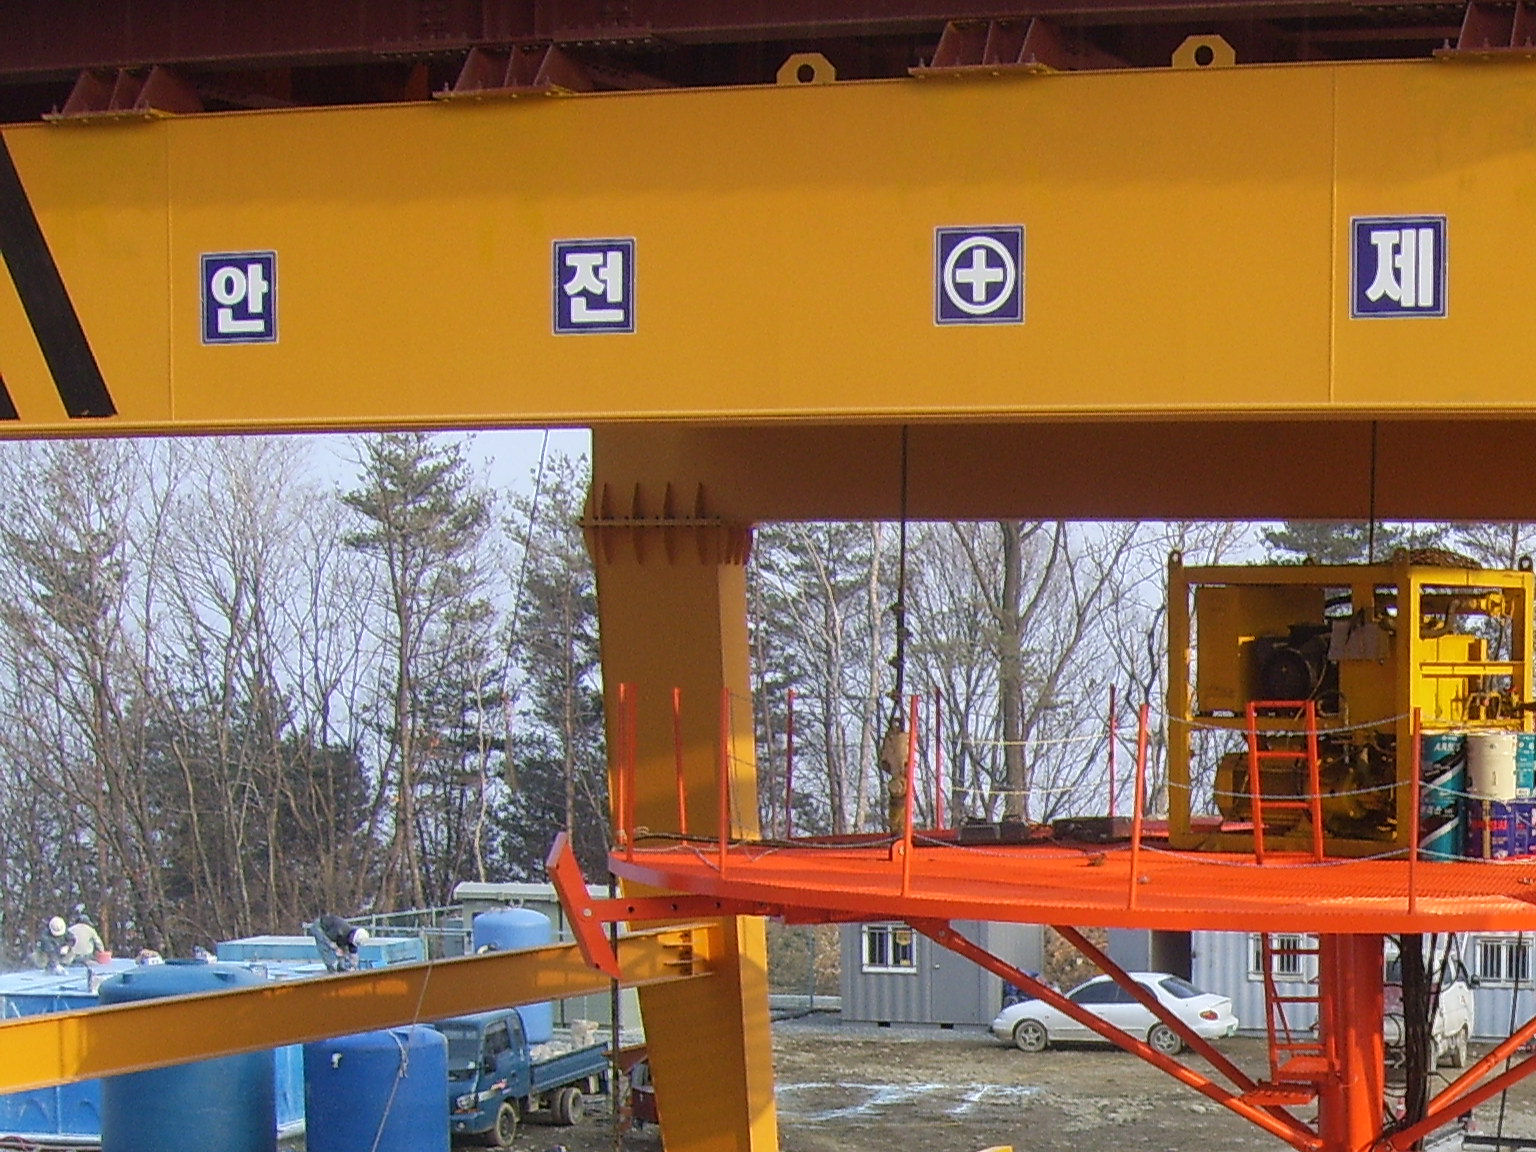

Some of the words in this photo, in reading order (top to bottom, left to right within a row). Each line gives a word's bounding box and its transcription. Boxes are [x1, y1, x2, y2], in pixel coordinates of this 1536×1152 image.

[211, 263, 269, 334] 안
[563, 250, 625, 324] 전
[1366, 227, 1434, 307] 제
